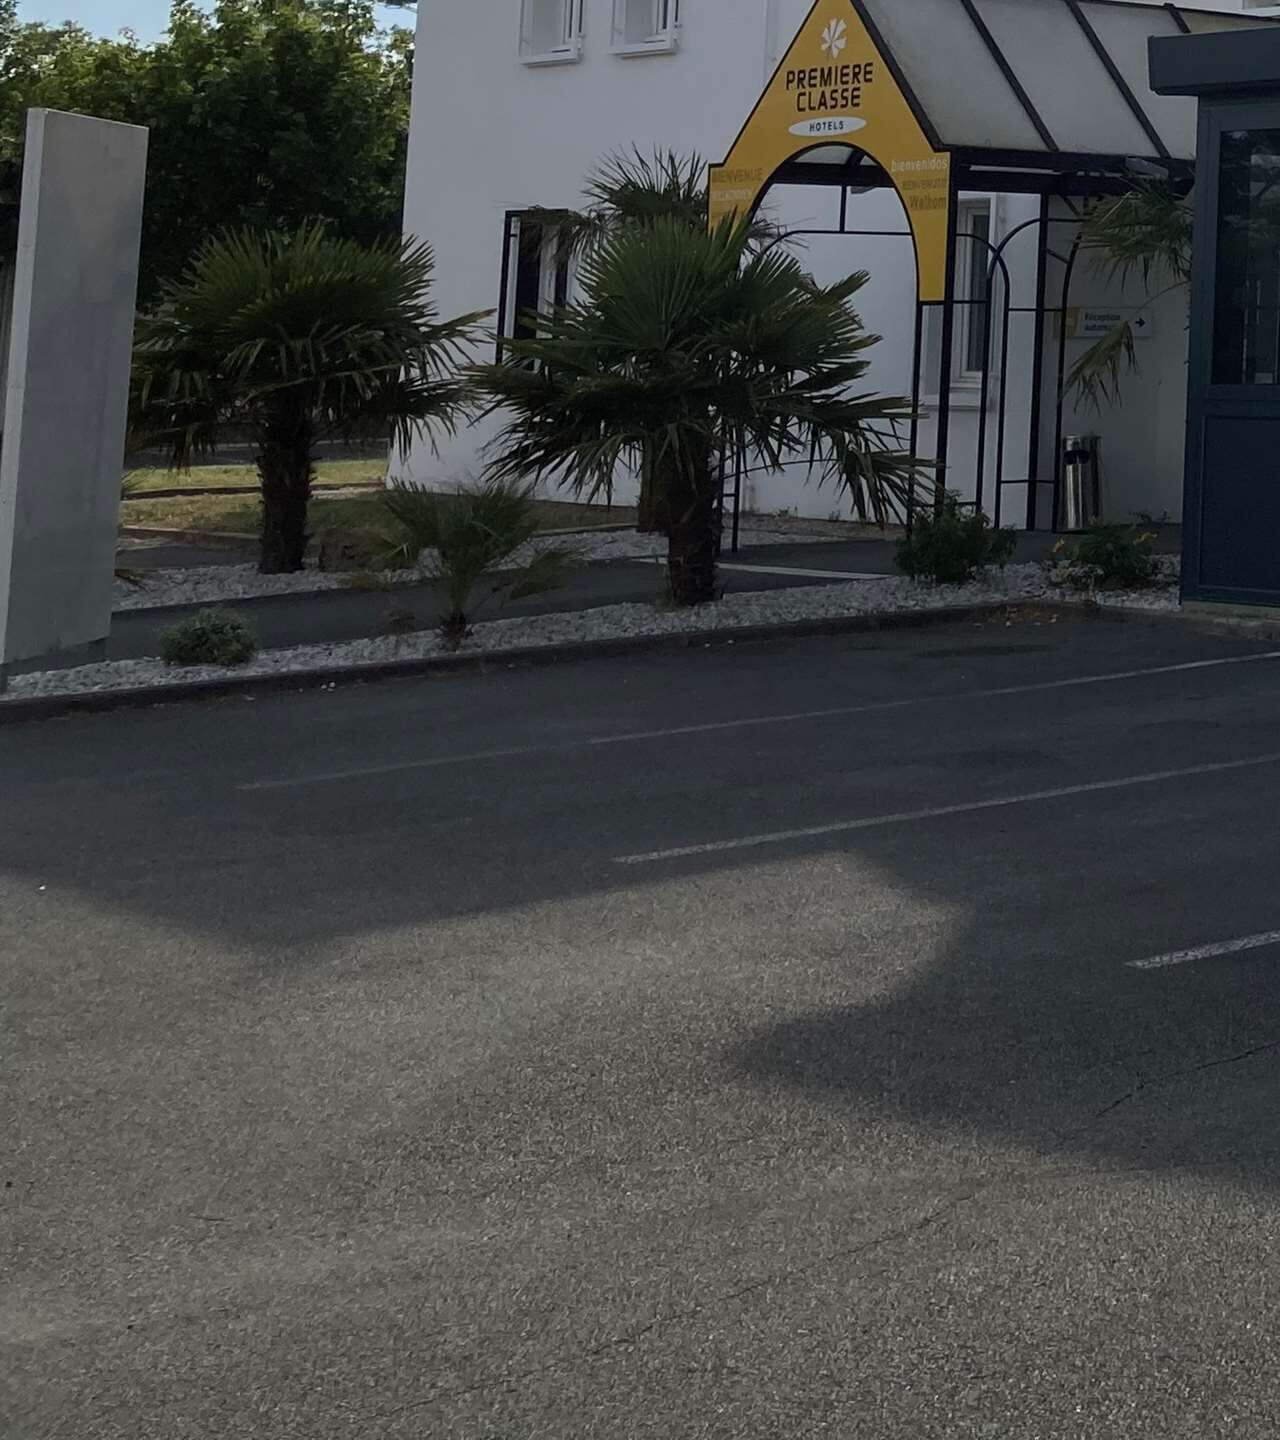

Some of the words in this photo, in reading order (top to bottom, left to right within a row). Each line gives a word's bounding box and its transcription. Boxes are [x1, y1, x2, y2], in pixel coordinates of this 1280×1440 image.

[786, 62, 874, 91] PREMIERE
[796, 87, 861, 112] CLASSE
[809, 121, 844, 132] HOTELS
